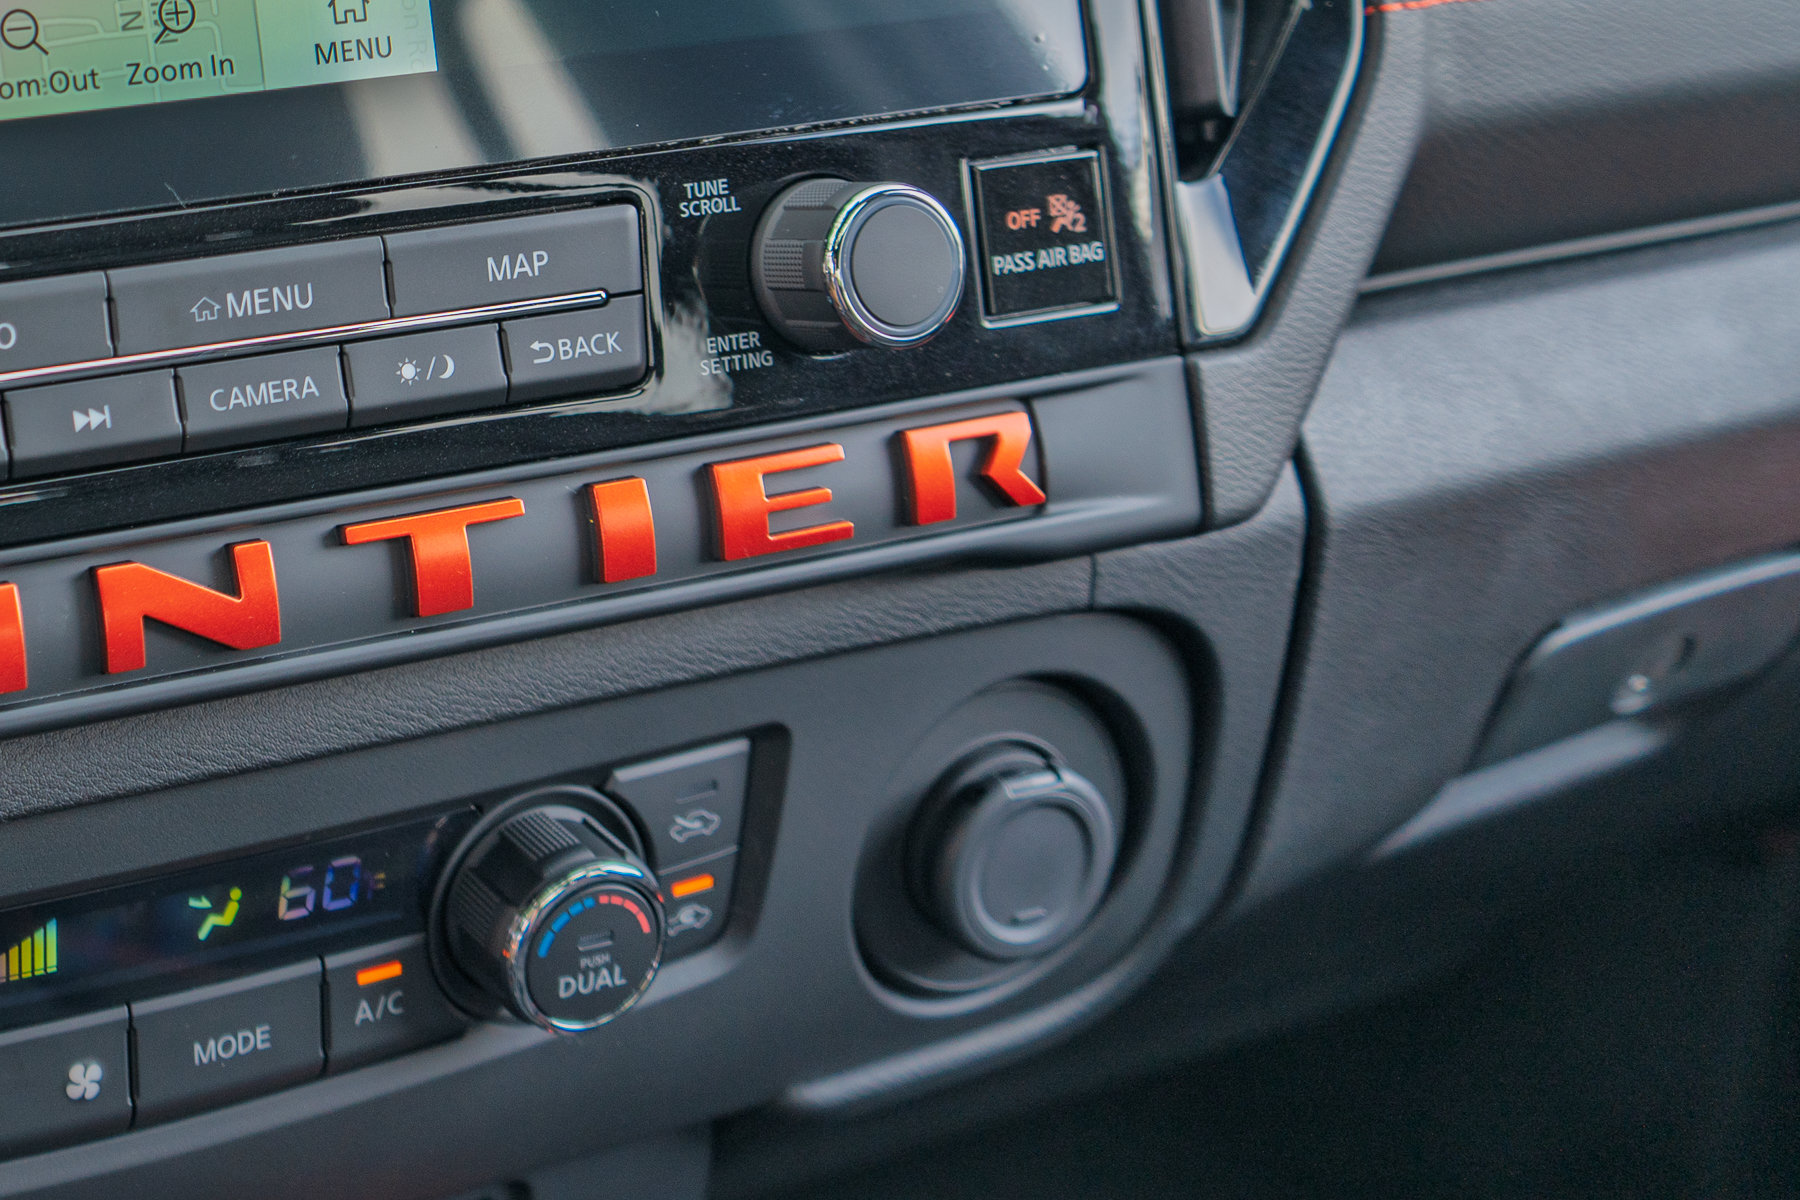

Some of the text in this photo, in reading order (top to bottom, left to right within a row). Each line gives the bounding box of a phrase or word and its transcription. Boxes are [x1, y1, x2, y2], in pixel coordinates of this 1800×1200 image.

[314, 36, 393, 65] MENU
[50, 68, 100, 93] Out
[126, 54, 235, 86] Zoom In
[683, 178, 729, 199] TUNE
[679, 195, 741, 219] SCROLL
[1006, 208, 1041, 230] OFF
[486, 250, 550, 283] MAP
[991, 241, 1106, 276] PASS AIR BAG
[226, 282, 315, 319] MENU
[557, 331, 622, 361] BACK
[706, 331, 761, 354] ENTER
[699, 349, 774, 376] SETTING
[209, 375, 320, 413] CAMERA
[558, 964, 628, 999] DUAL
[355, 992, 404, 1025] A/C
[193, 1026, 271, 1066] MODE
